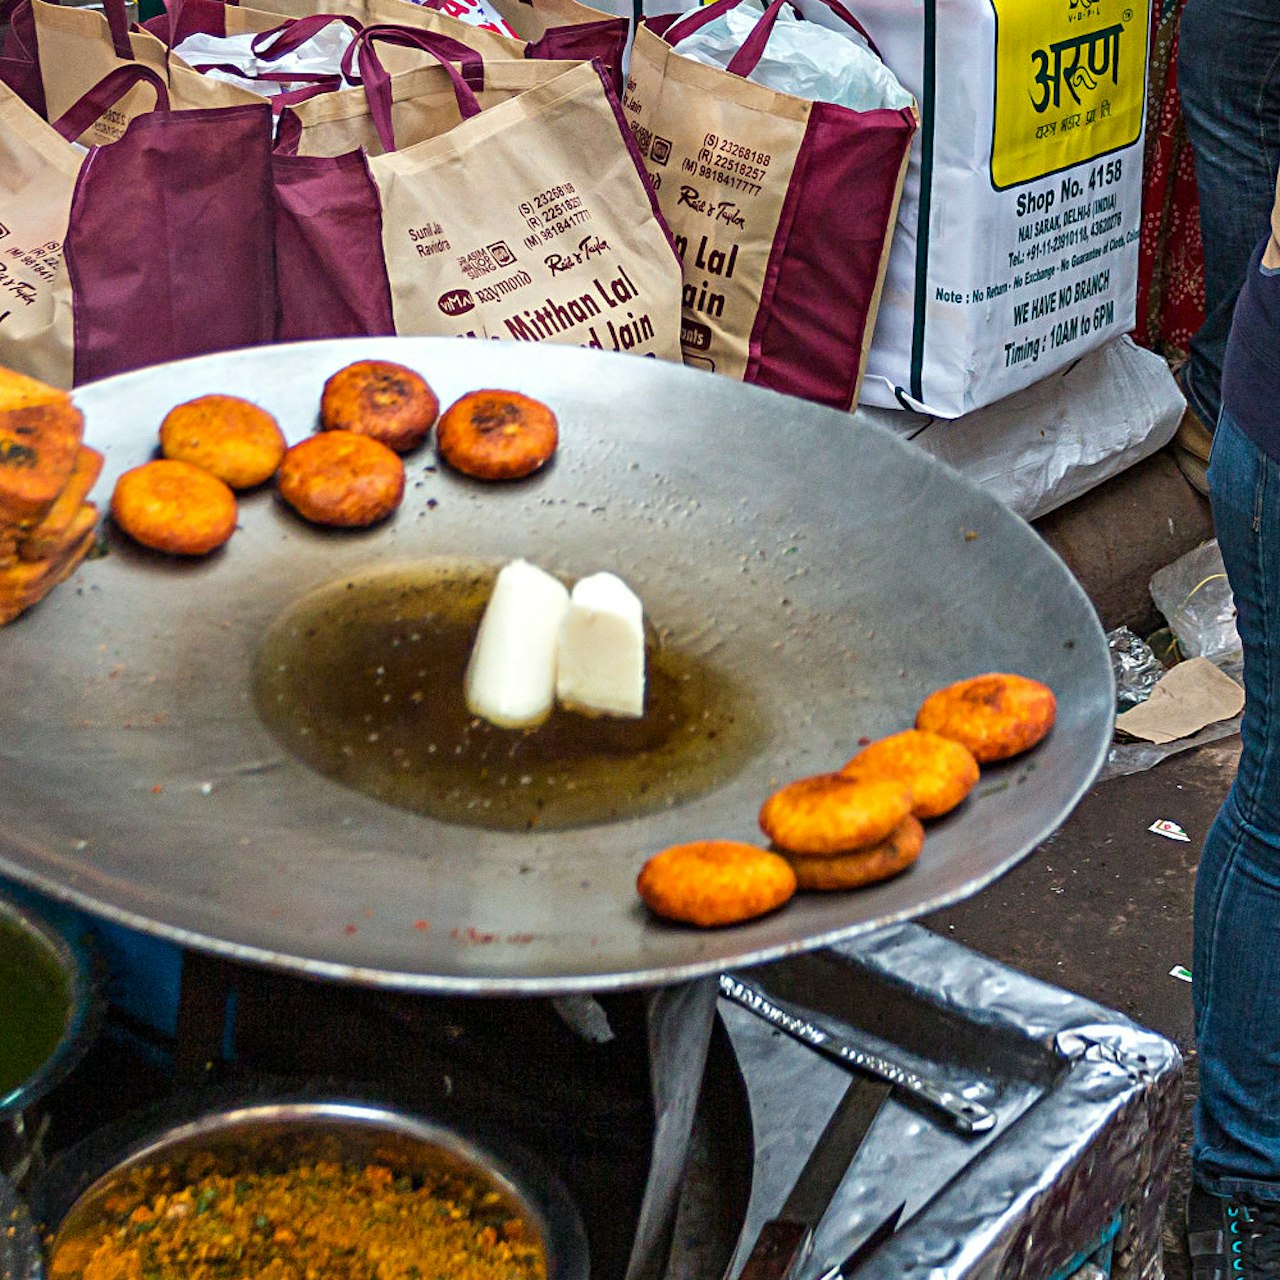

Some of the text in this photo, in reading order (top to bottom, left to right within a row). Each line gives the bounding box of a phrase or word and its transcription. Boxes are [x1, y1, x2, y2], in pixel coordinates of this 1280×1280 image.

[698, 148, 767, 182] (R) 22518257
[703, 133, 771, 167] (S) 23268188
[682, 157, 762, 197] (M) 9818417777
[1016, 159, 1122, 217] Shop No. 4158
[518, 199, 535, 217] (S)
[526, 218, 542, 232] (R)
[523, 233, 541, 250] (M)
[1018, 224, 1033, 243] NAI
[694, 235, 738, 279] Lal
[936, 287, 963, 304] Note
[972, 290, 984, 304] No
[986, 283, 1008, 299] Return
[1013, 275, 1023, 289] No
[1025, 266, 1055, 286] Exchange
[1061, 258, 1070, 272] No
[1072, 247, 1102, 268] Guarantee
[504, 293, 601, 342] Mitthan
[593, 265, 639, 308] Lal
[683, 280, 726, 318] ain
[1013, 269, 1110, 326] WE HAVE NO BRANCH
[607, 312, 655, 352] Jain
[1004, 335, 1040, 367] Timing
[1050, 317, 1078, 349] 10AM
[1081, 313, 1090, 331] to
[1093, 300, 1114, 330] 6PM
